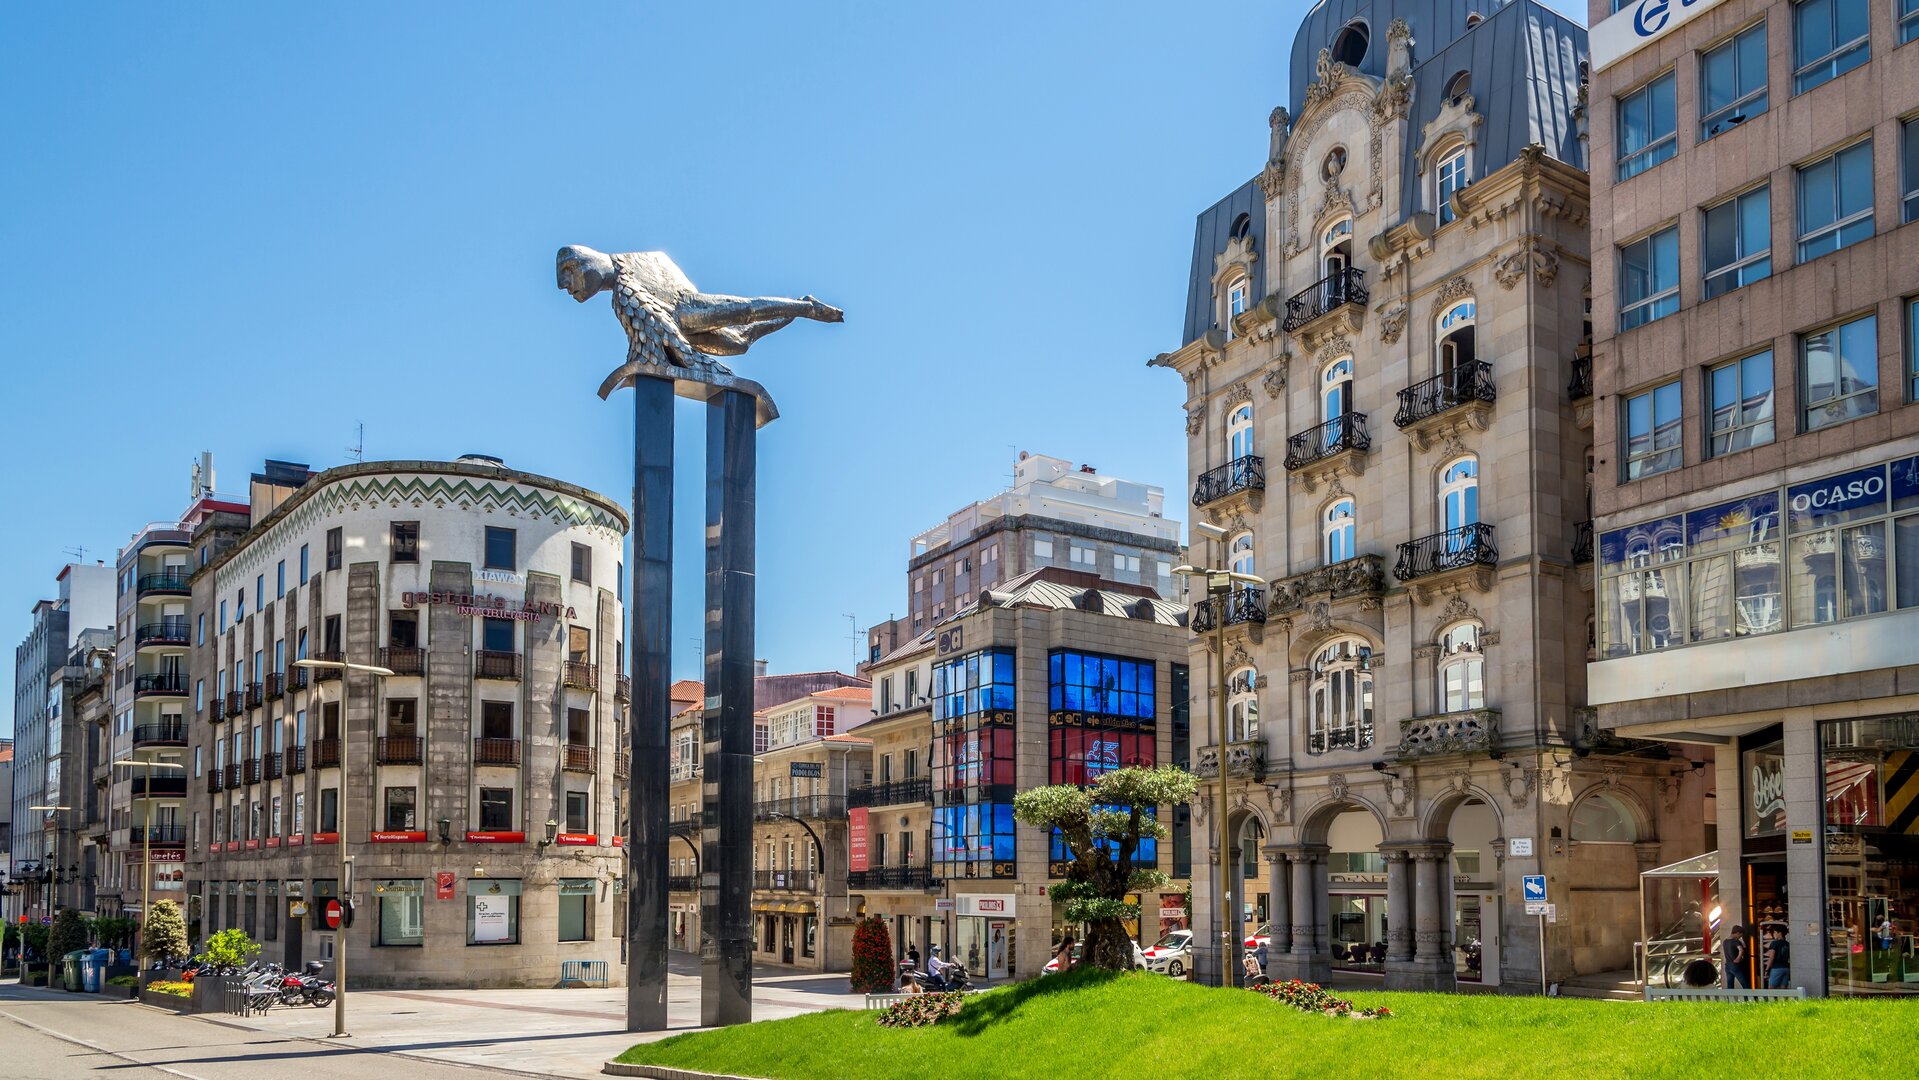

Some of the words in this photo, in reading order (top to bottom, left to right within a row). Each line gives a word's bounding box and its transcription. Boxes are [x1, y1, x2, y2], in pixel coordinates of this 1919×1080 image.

[1792, 477, 1884, 512] OCASO
[401, 591, 507, 609] gestoría
[523, 600, 578, 620] ANTA
[457, 606, 542, 622] INMOBILIARIA
